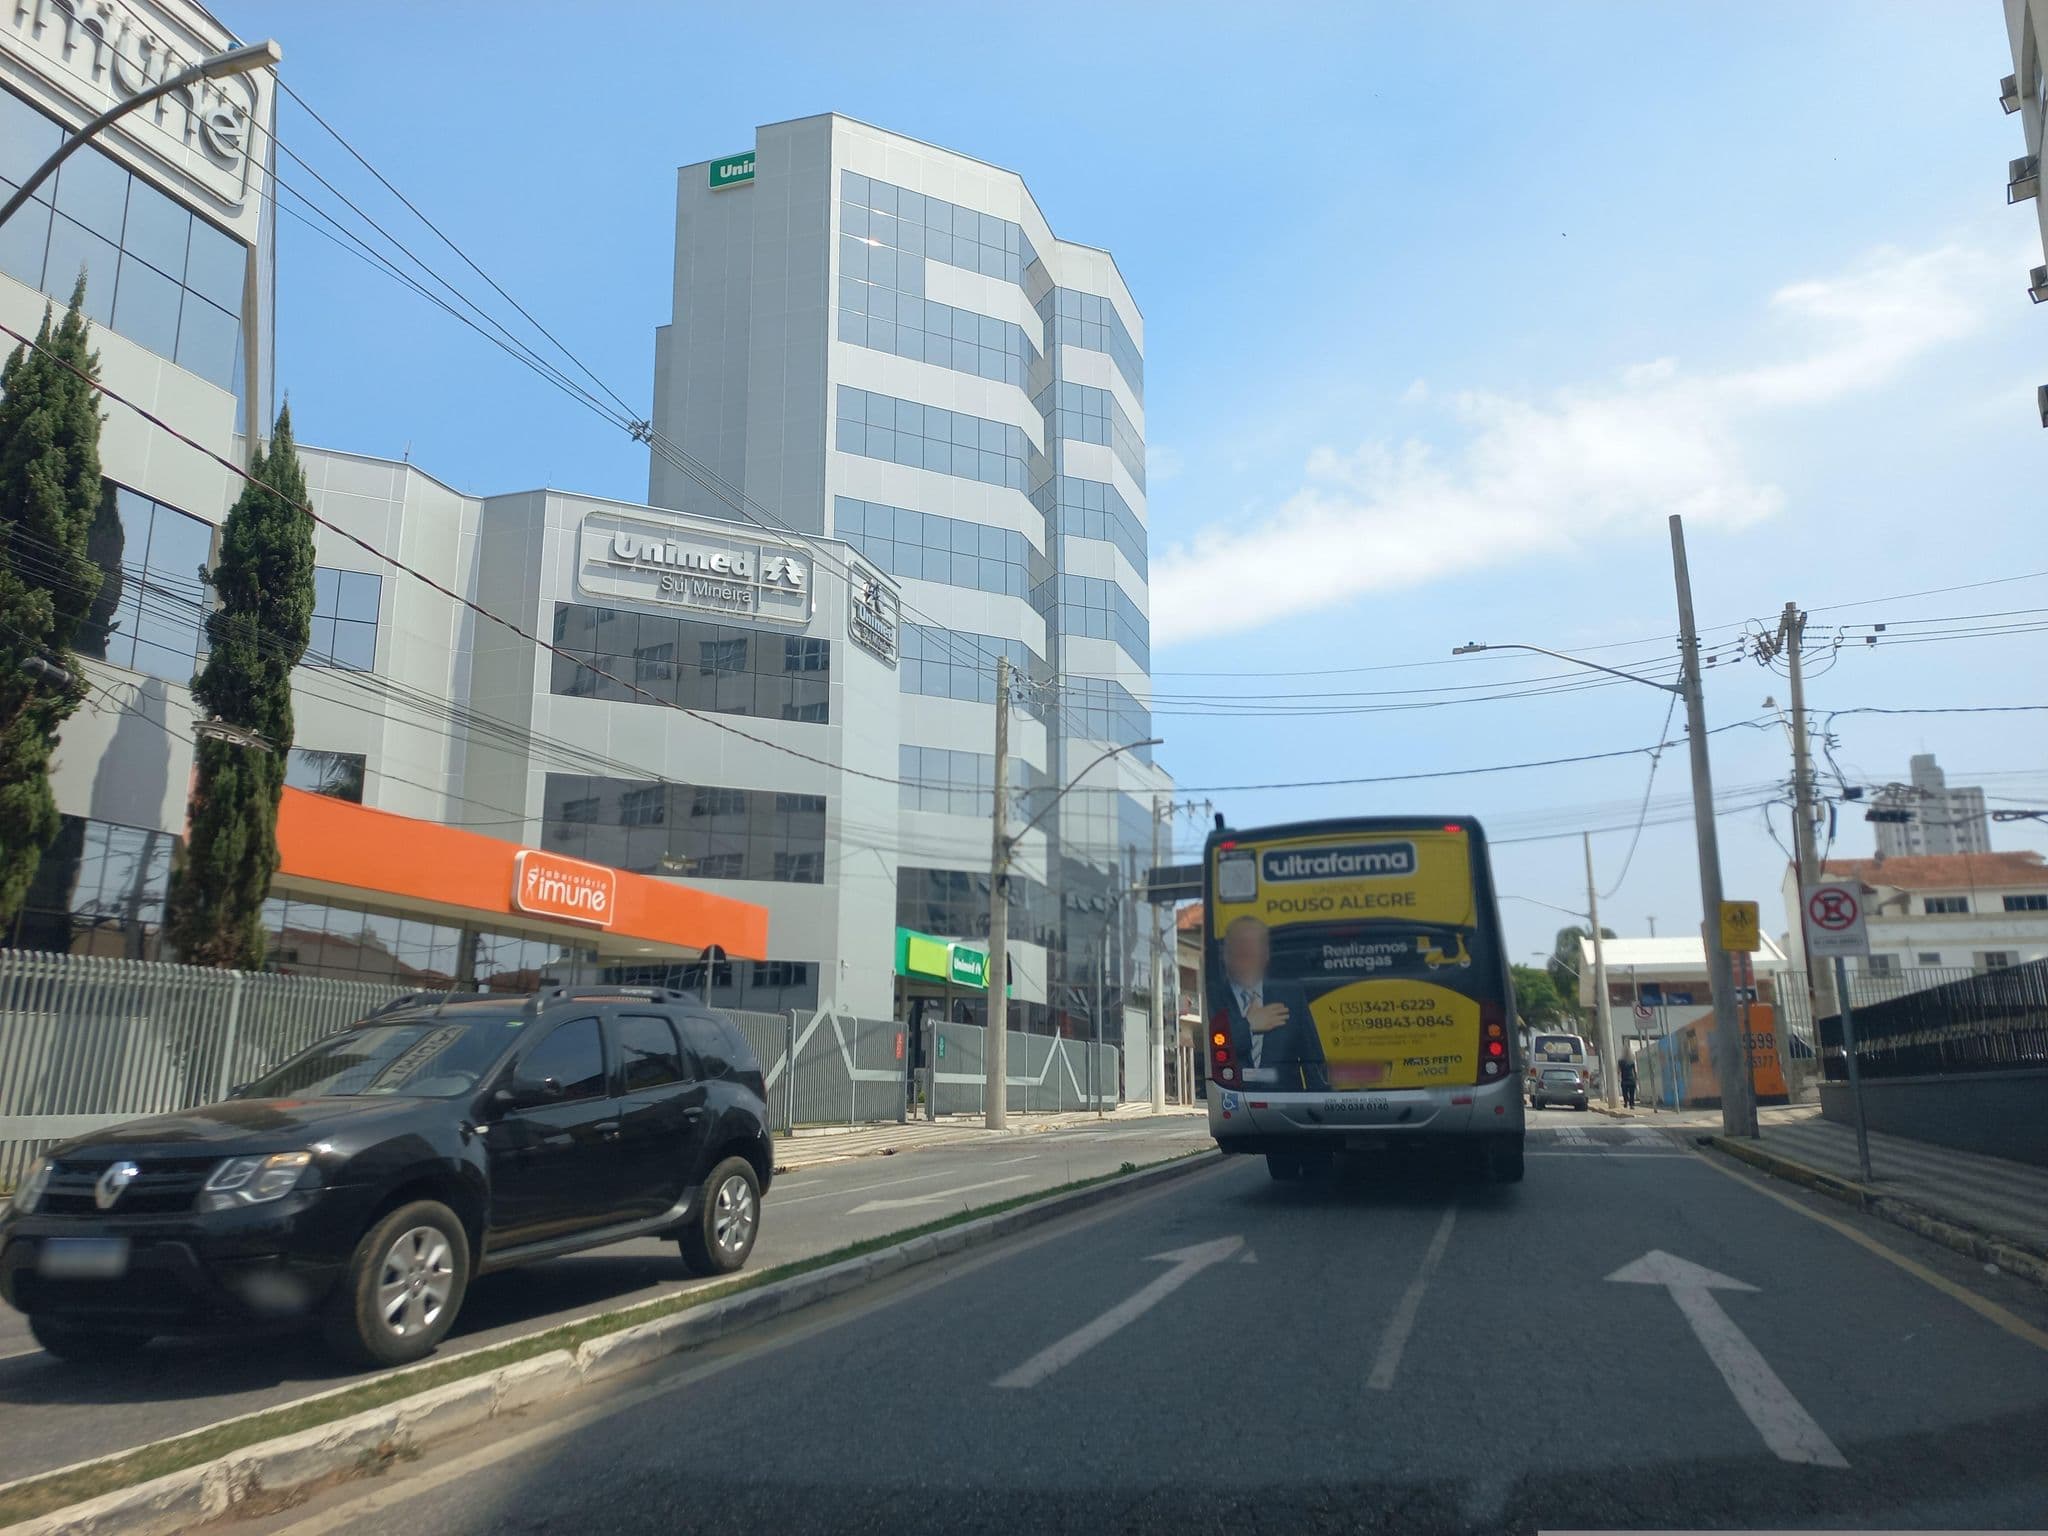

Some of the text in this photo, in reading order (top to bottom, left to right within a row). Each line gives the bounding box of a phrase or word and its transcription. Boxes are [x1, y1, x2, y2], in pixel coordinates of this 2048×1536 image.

[613, 531, 753, 578] Unimed
[661, 574, 753, 603] Sul Mineira
[1269, 850, 1409, 877] ultrafarma
[537, 876, 606, 912] imune
[1266, 896, 1335, 913] POUSO
[1339, 891, 1416, 910] ALEGRE
[1322, 940, 1408, 958] Realizamos
[1323, 954, 1393, 971] entregas
